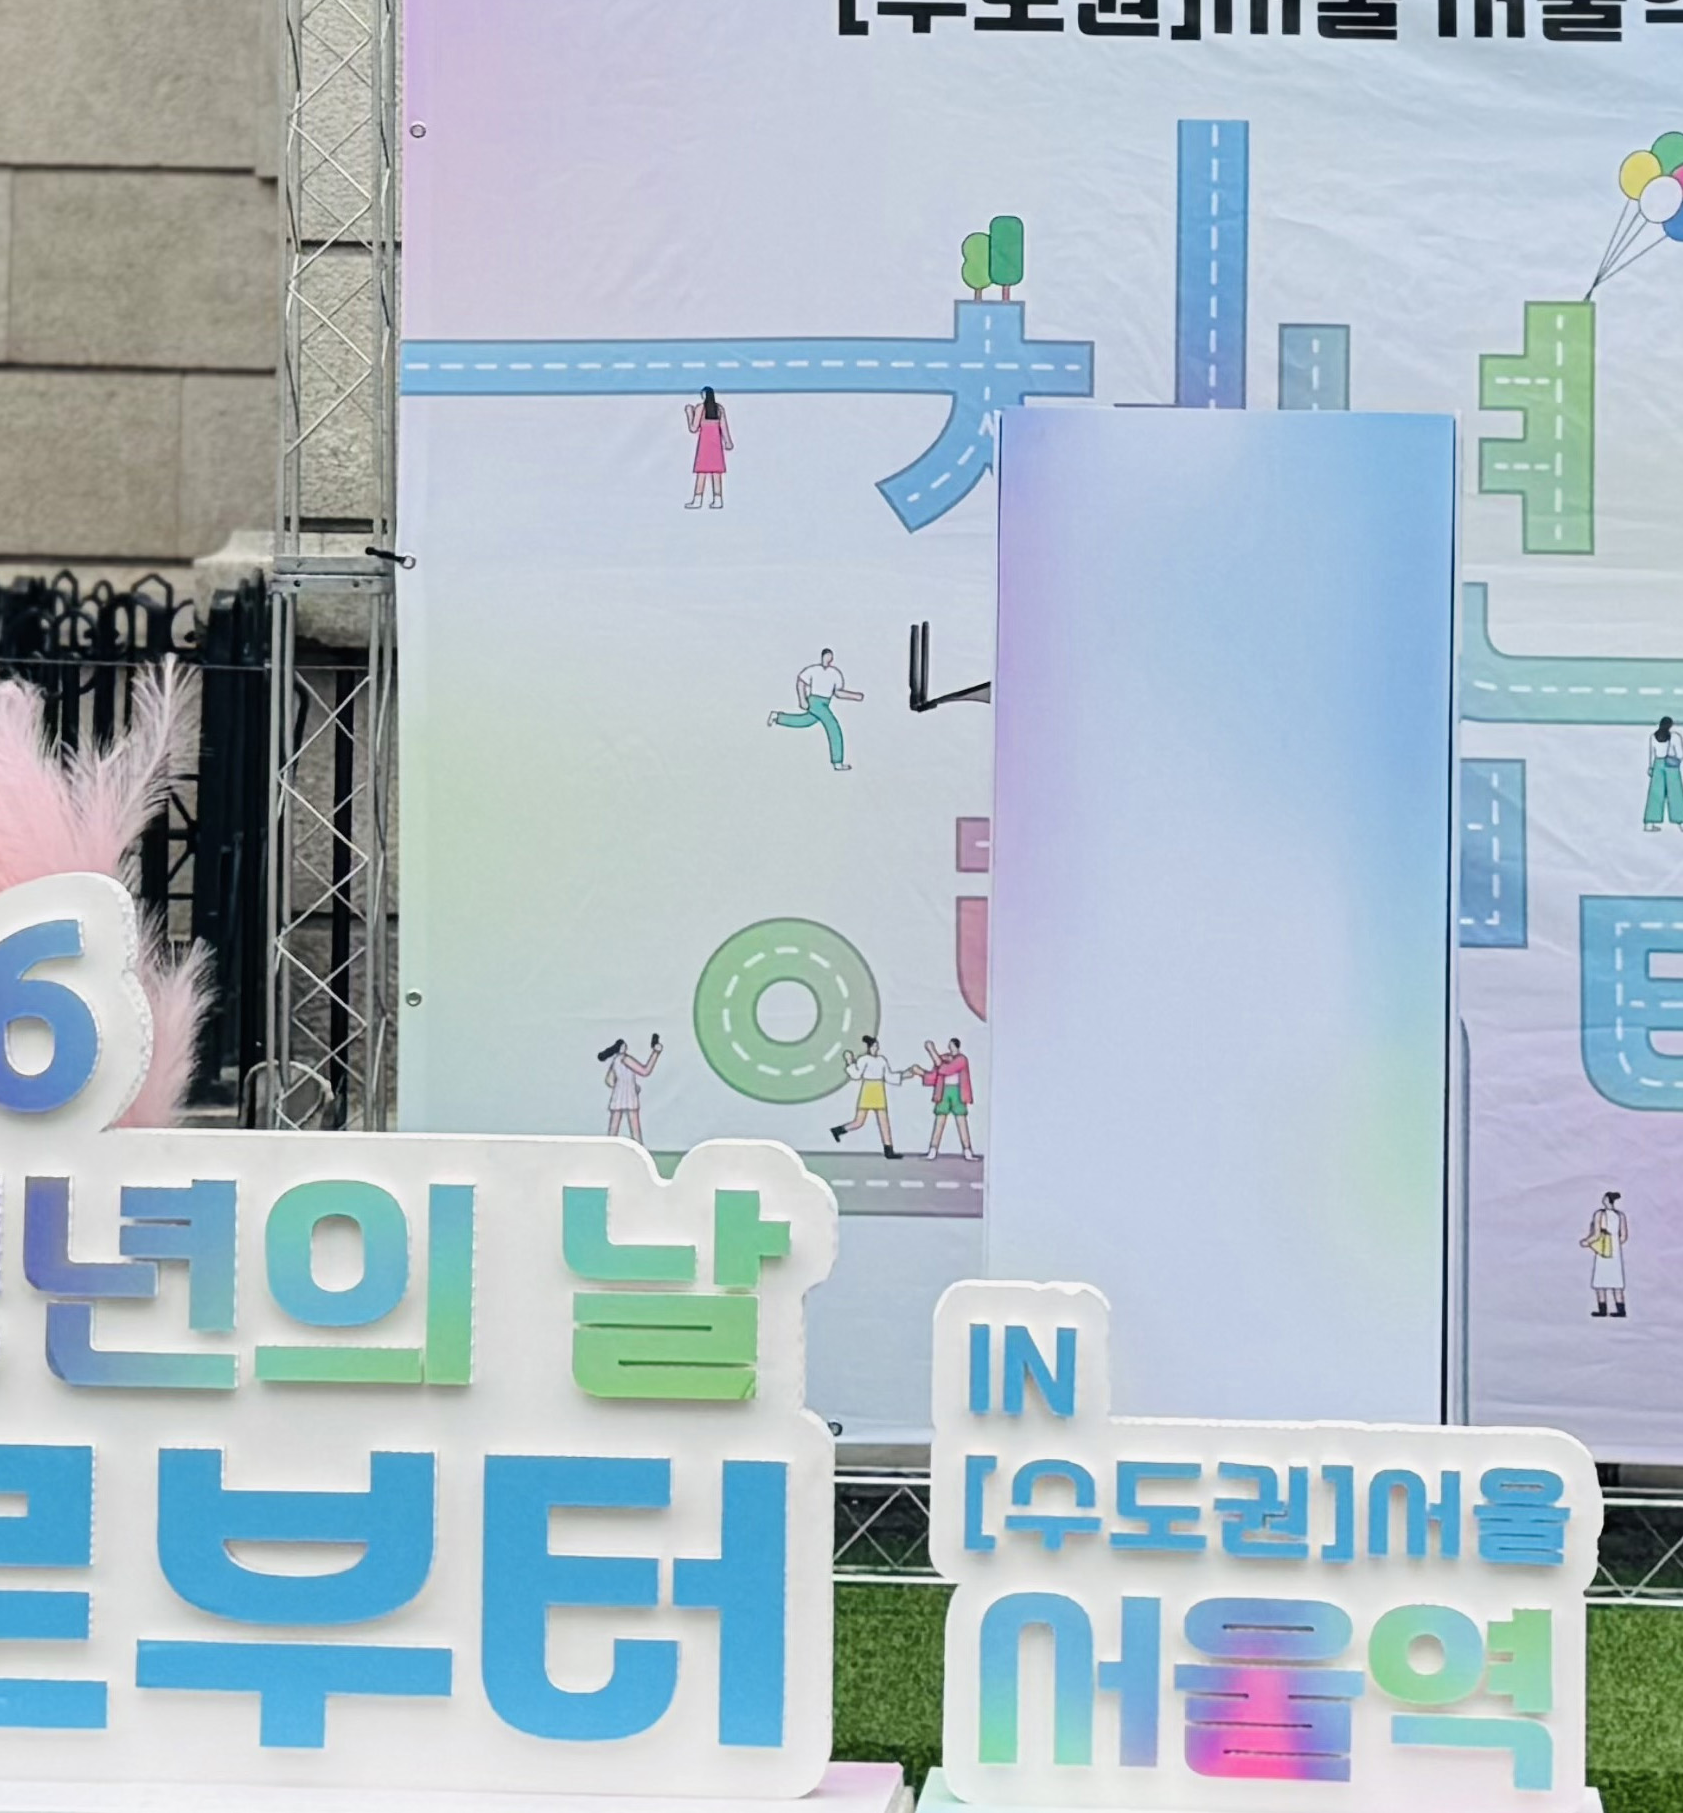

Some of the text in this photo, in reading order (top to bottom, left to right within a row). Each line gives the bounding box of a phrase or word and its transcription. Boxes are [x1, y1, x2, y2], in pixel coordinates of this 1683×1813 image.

[562, 1186, 790, 1401] 날
[969, 1323, 1077, 1418] IN
[963, 1454, 1571, 1566] [수도권]서울
[978, 1592, 1554, 1791] 서울역
